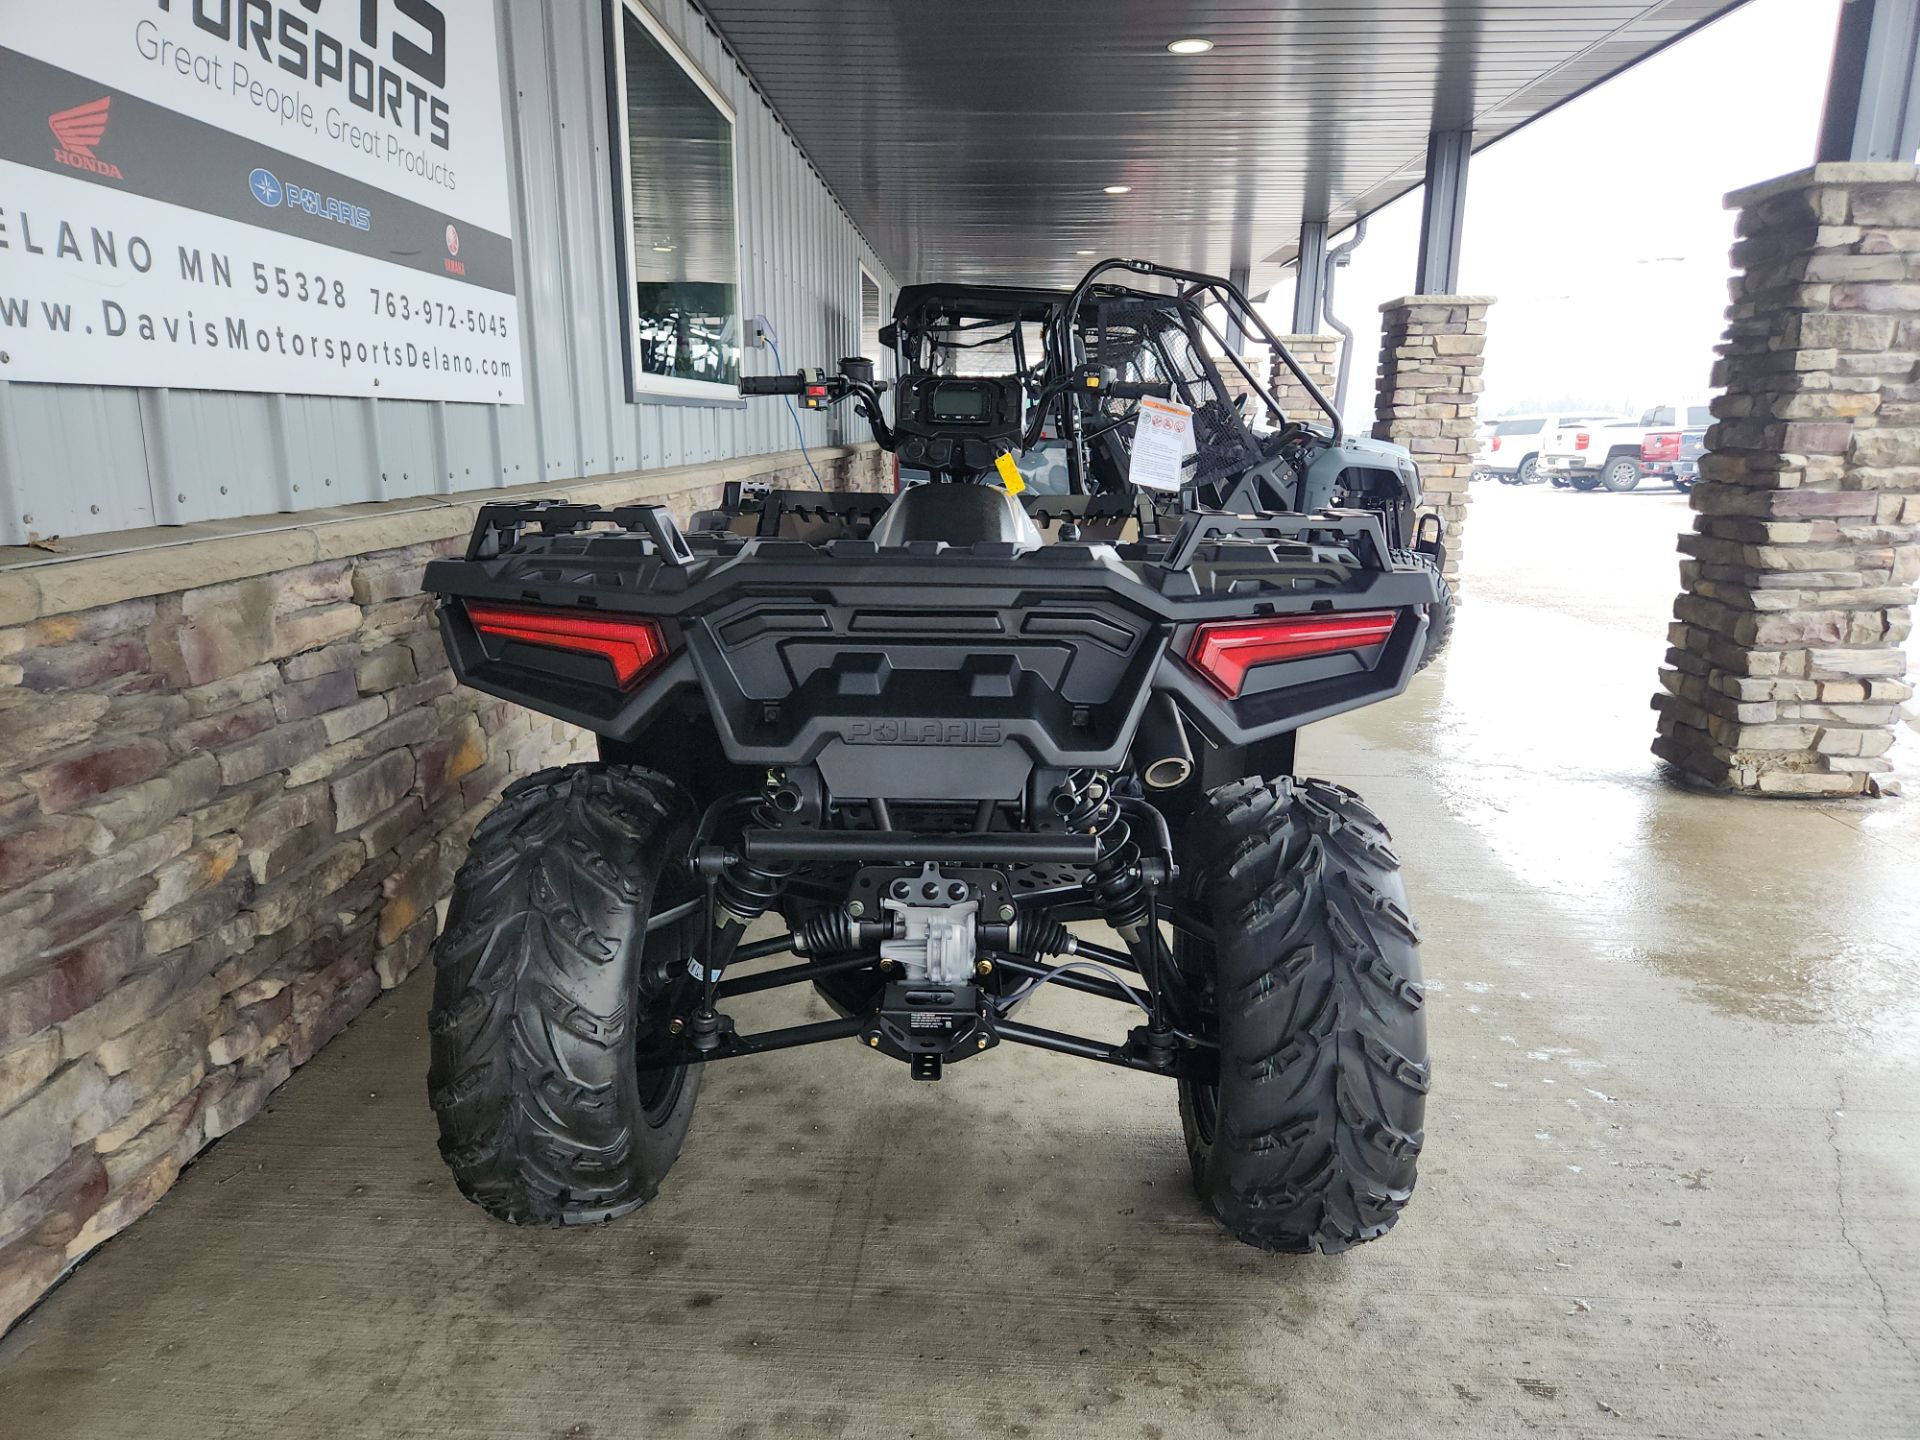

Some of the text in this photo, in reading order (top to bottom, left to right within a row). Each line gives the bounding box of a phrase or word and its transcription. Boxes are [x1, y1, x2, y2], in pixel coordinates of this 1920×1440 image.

[136, 19, 456, 191] Great People, Great Products
[157, 0, 449, 151] ORSPORTS
[53, 149, 124, 180] HONDA
[285, 182, 371, 232] POLARIS
[178, 246, 232, 288] MN
[253, 262, 346, 308] 55328
[370, 288, 507, 338] 763-972-5045
[848, 720, 1001, 743] POLARIS
